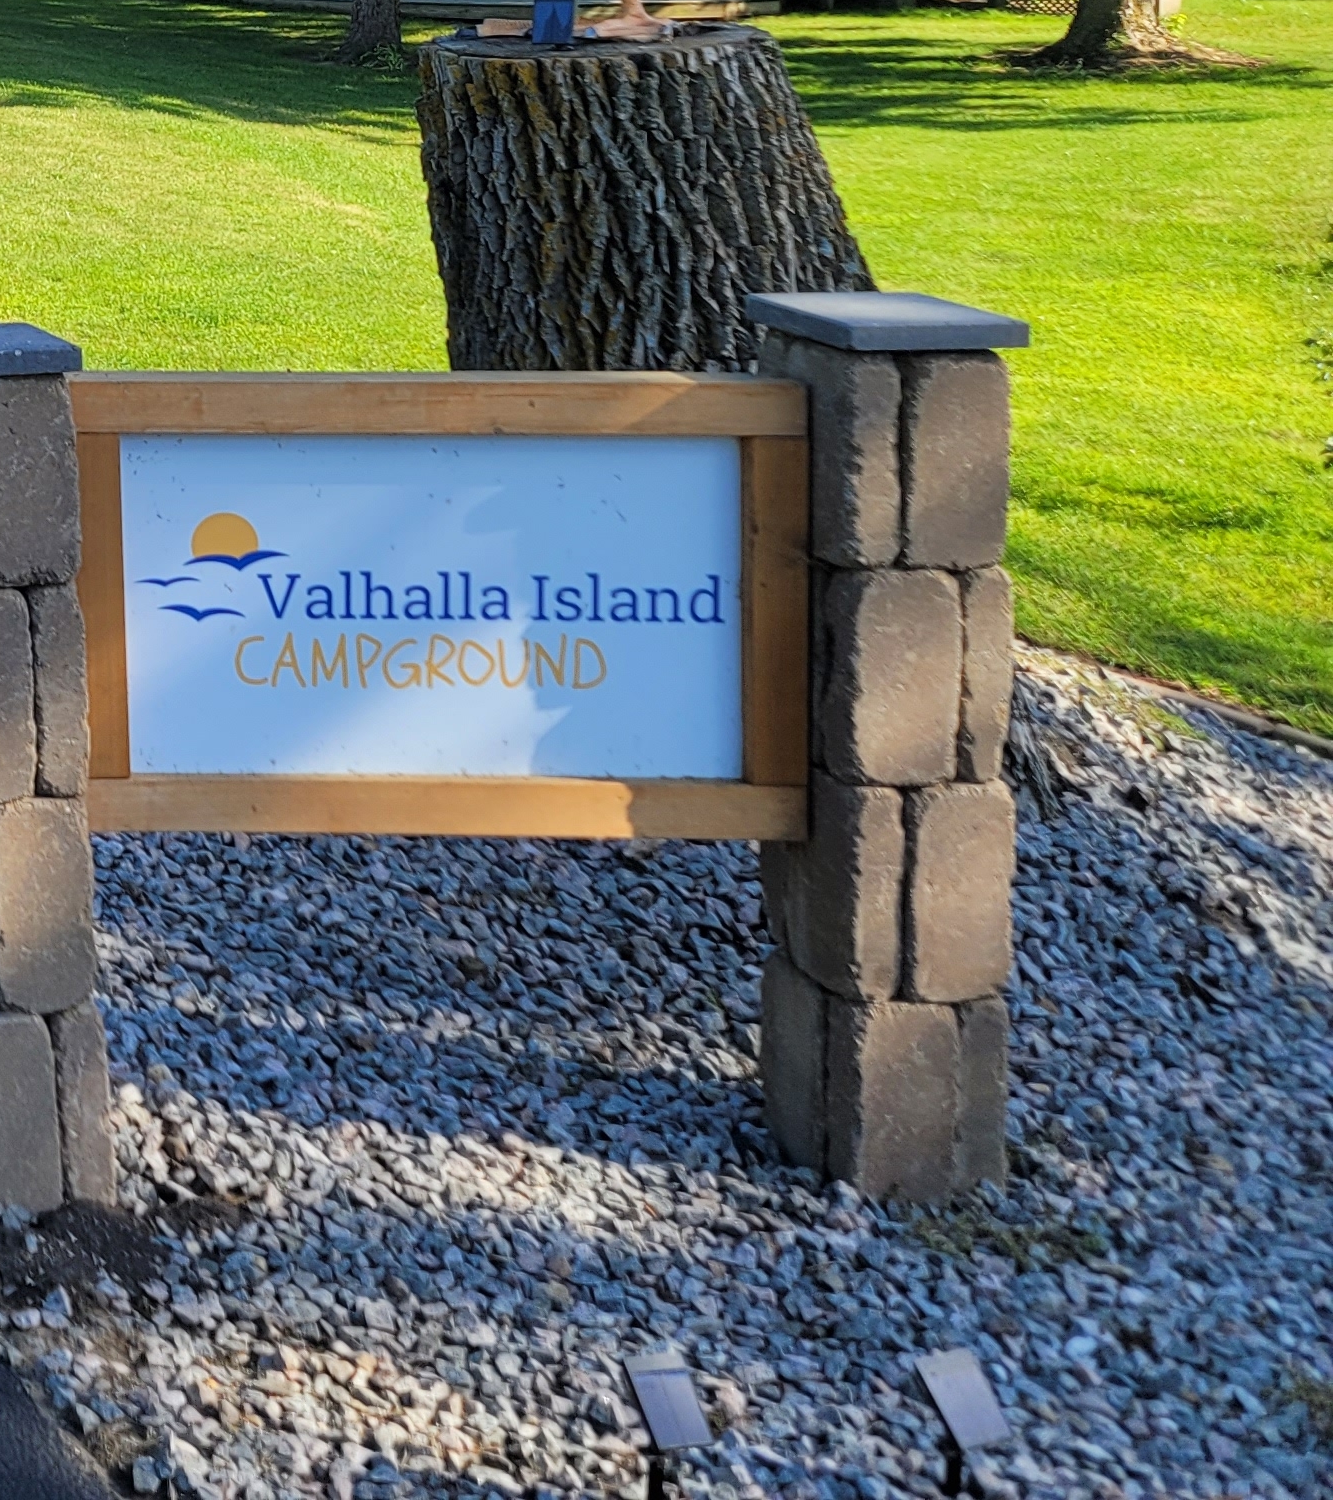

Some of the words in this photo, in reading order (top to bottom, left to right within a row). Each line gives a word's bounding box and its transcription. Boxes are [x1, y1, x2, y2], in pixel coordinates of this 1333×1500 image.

[257, 571, 513, 620] Valhalla
[530, 573, 726, 623] Island
[234, 632, 608, 690] CAMPGROUND
